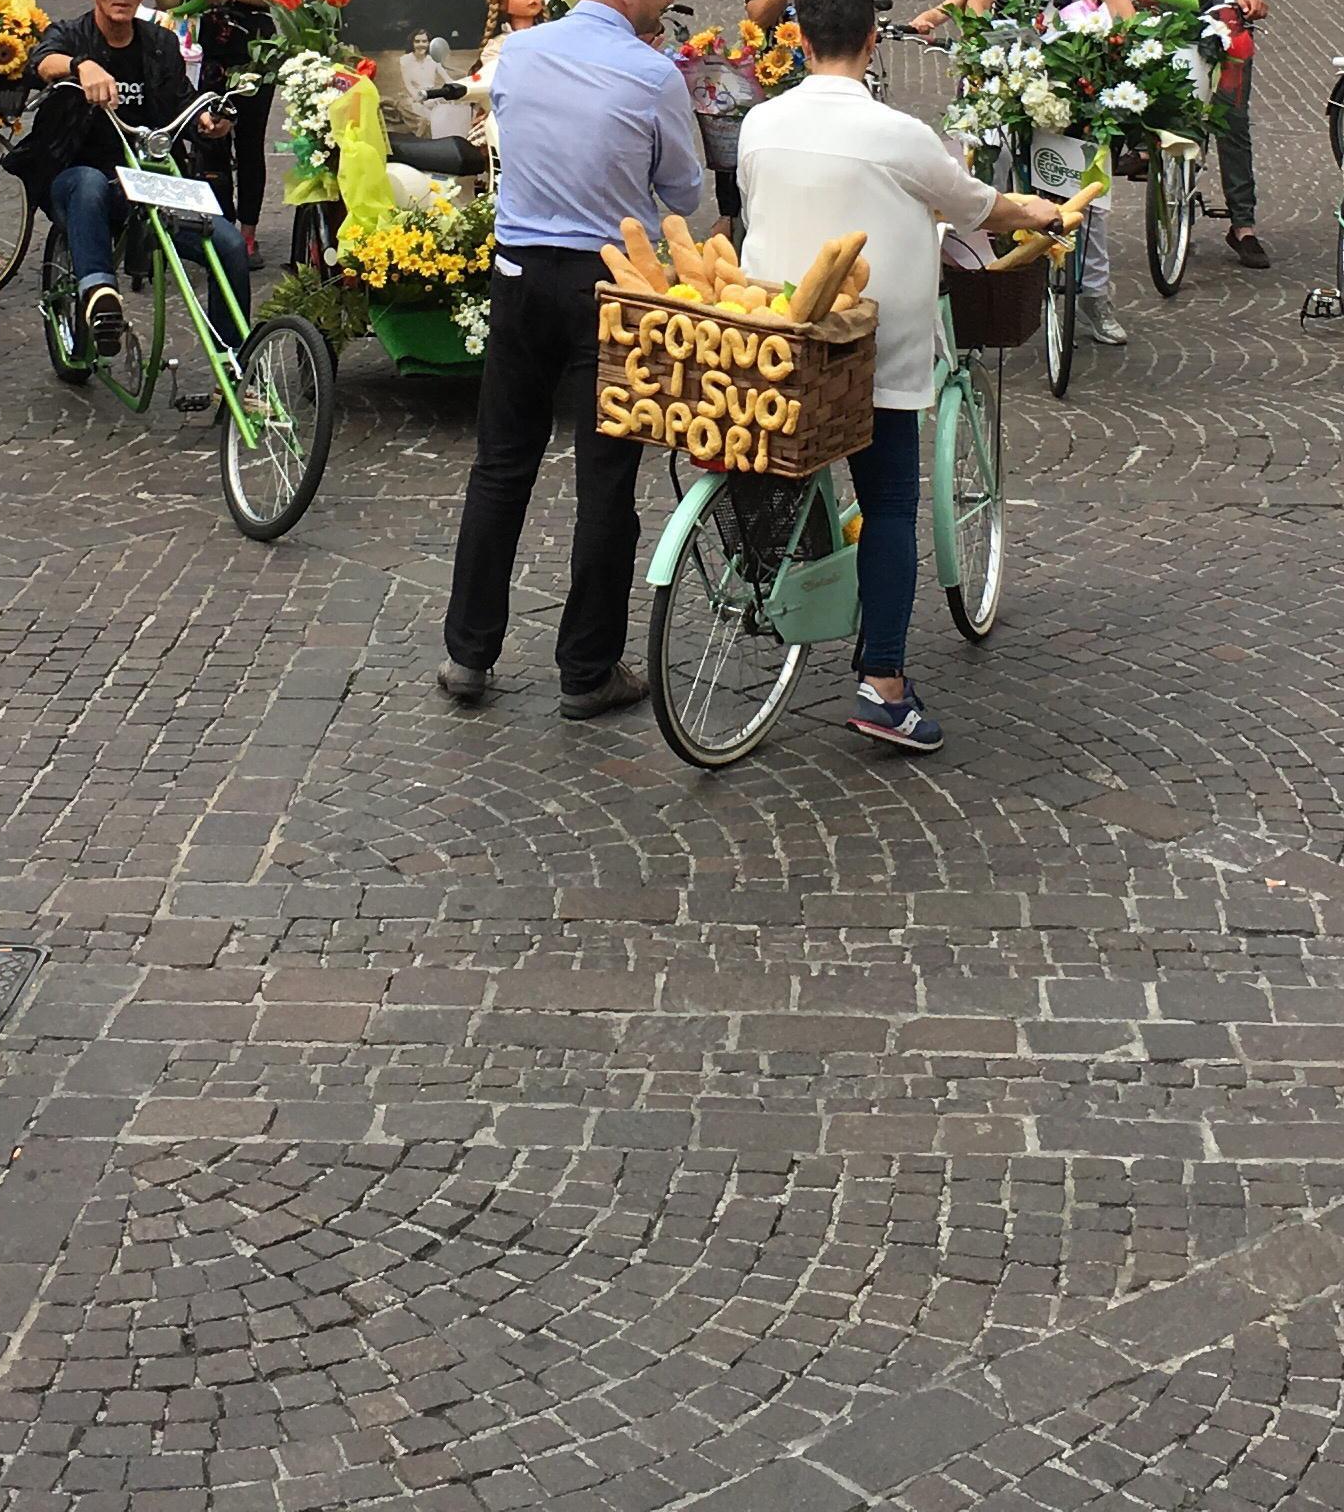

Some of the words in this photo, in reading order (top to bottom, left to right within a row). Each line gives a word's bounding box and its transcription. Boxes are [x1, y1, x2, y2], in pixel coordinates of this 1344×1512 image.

[598, 301, 636, 346] IL
[639, 309, 795, 382] FORNO
[600, 385, 769, 474] SAPORI
[625, 347, 662, 397] E
[670, 361, 684, 398] I
[697, 369, 802, 436] SUOI
